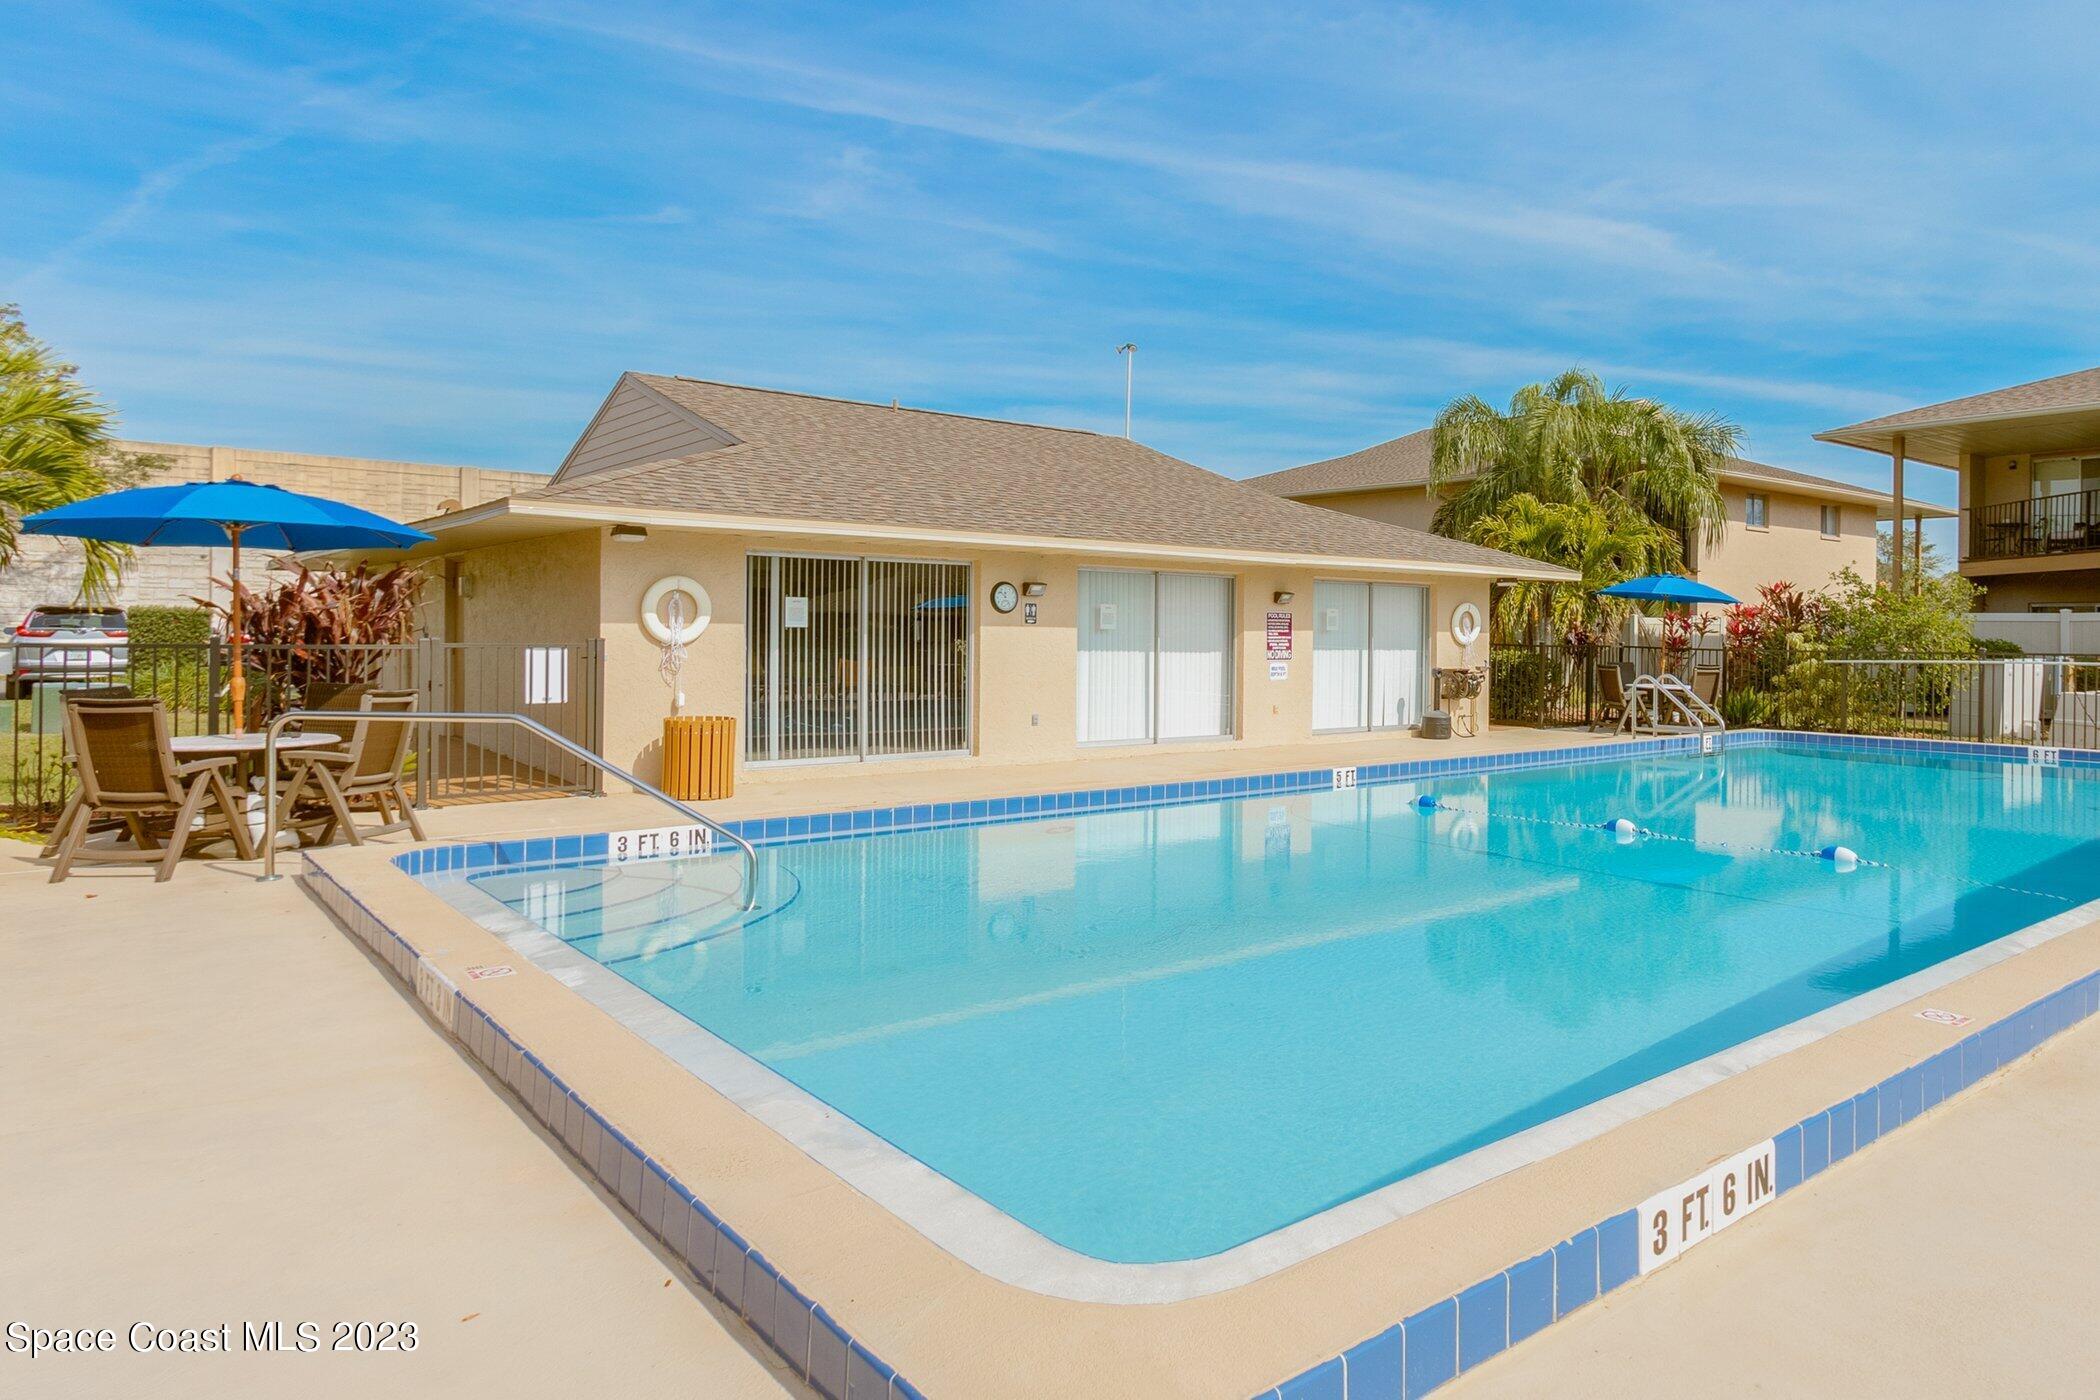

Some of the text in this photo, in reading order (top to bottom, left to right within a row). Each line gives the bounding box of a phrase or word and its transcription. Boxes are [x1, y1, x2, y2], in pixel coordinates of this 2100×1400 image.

[2033, 750, 2039, 759] 6
[1336, 771, 1342, 782] 5
[618, 828, 710, 853] 3 FT. 6 IN.
[1653, 1153, 1773, 1256] 3 FT. 6 IN.
